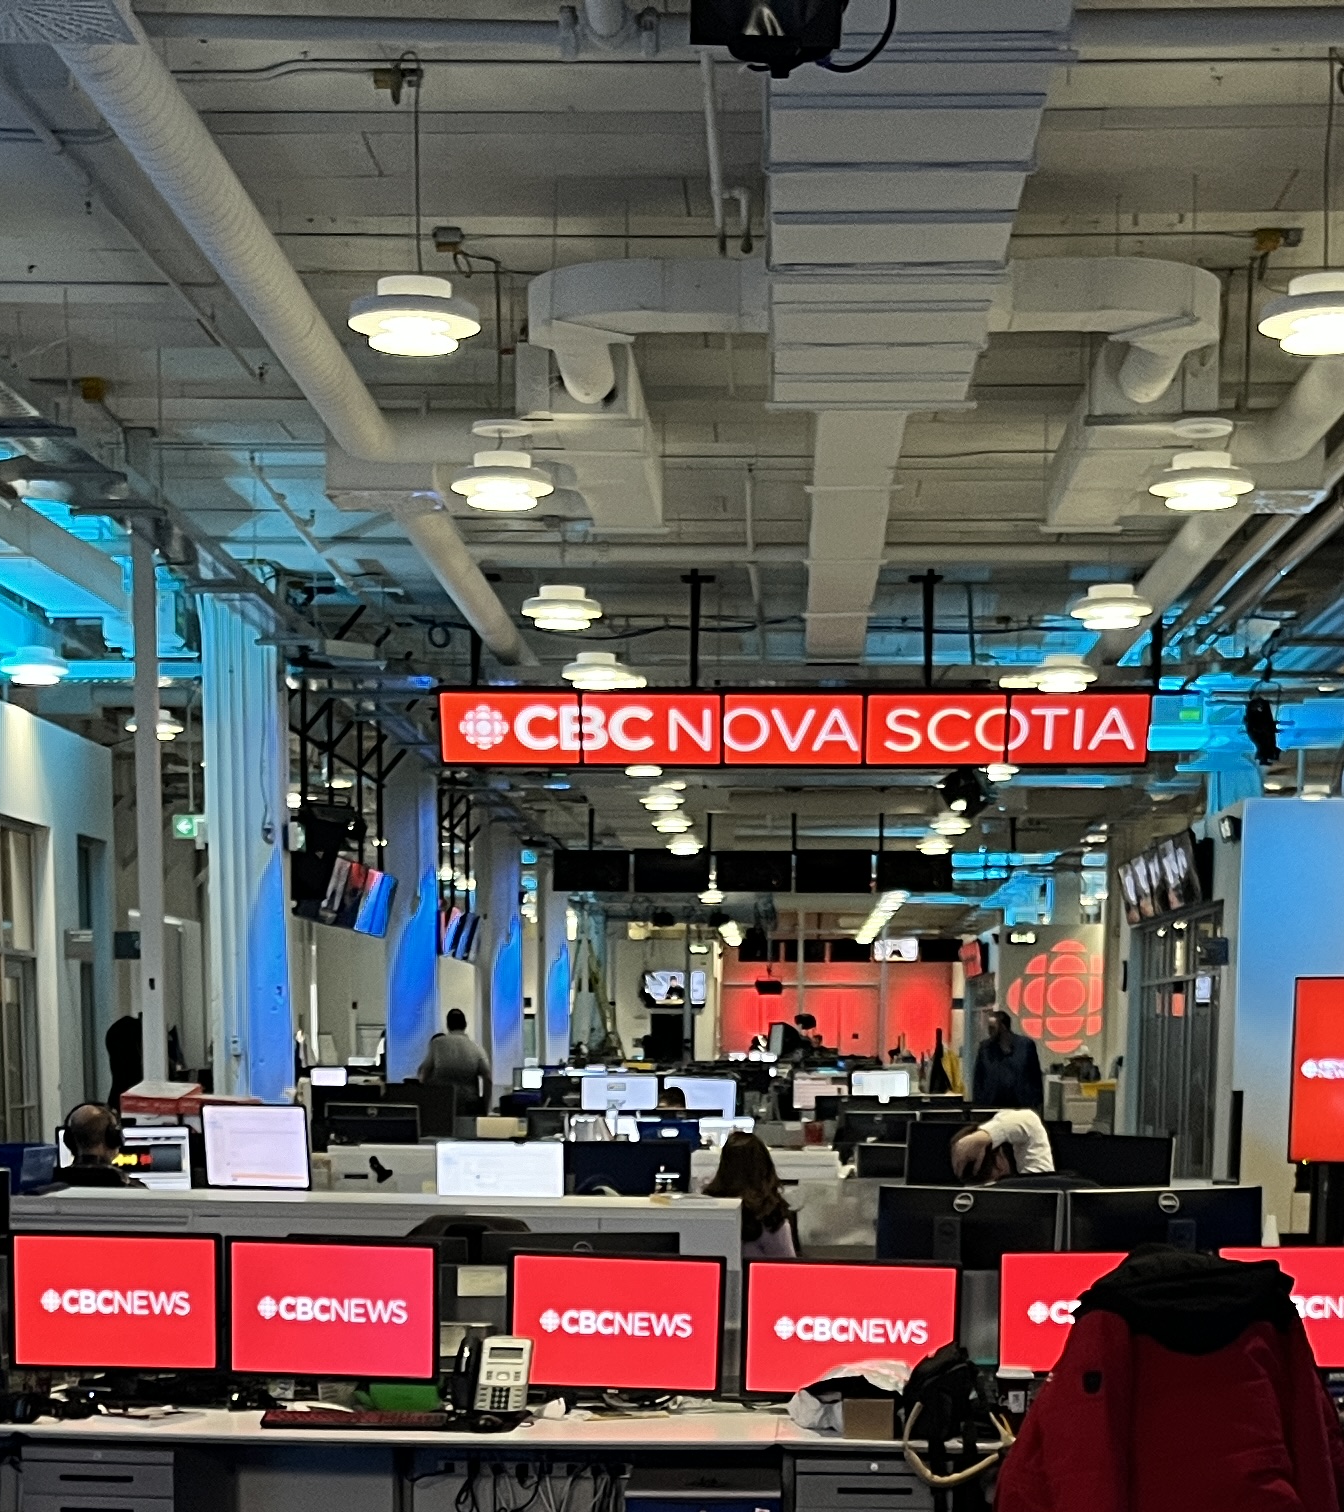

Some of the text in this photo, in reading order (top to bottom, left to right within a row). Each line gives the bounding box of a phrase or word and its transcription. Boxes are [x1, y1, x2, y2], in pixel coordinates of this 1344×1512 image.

[513, 705, 1135, 752] CBC NOVA SCOTIA
[61, 1289, 191, 1316] CBCNEWS
[278, 1296, 408, 1325] CBCNEWS
[560, 1309, 693, 1338] CBCNEWS
[796, 1316, 929, 1344] CBCNEWS
